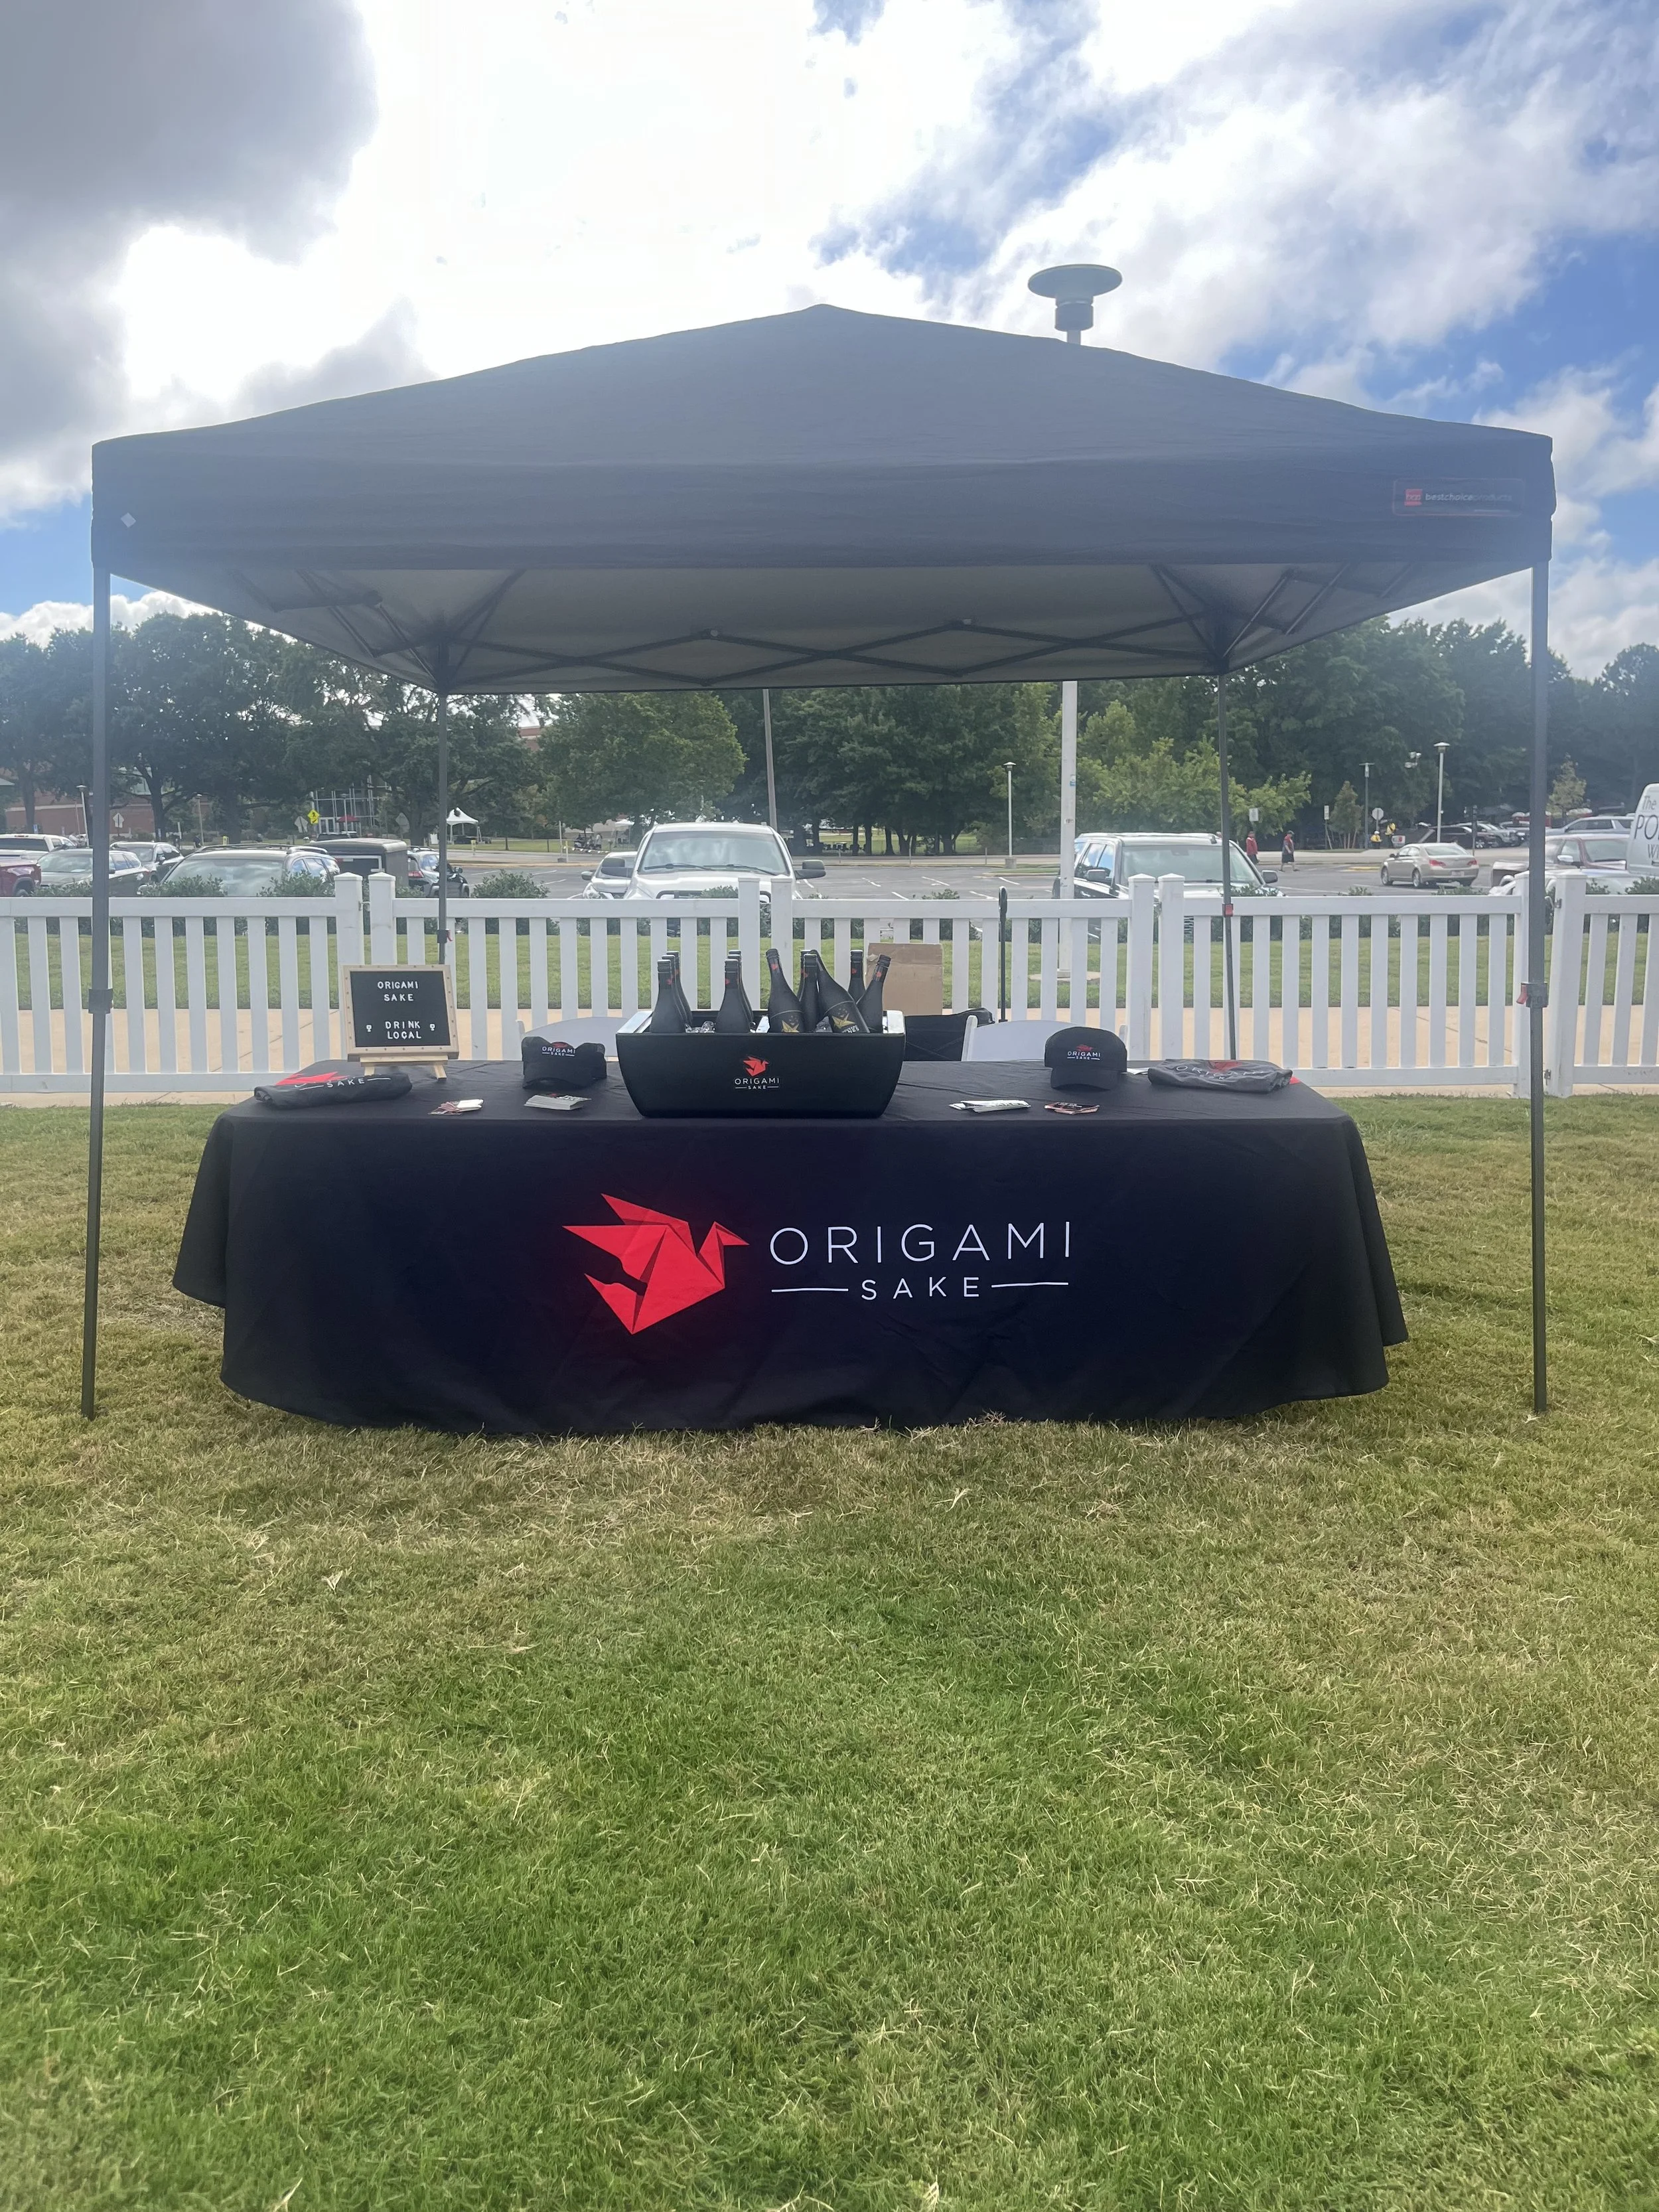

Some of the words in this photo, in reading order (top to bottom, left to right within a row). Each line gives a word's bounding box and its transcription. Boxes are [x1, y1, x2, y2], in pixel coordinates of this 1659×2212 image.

[1642, 796, 1657, 810] The
[1634, 814, 1659, 840] PO
[377, 981, 419, 990] ORIGAMI
[385, 1020, 421, 1029] DRINK
[387, 1031, 422, 1040] LOCAL
[326, 1077, 365, 1088] SAKE
[770, 1221, 1070, 1265] ORIGAMI
[861, 1276, 980, 1301] SAKE
